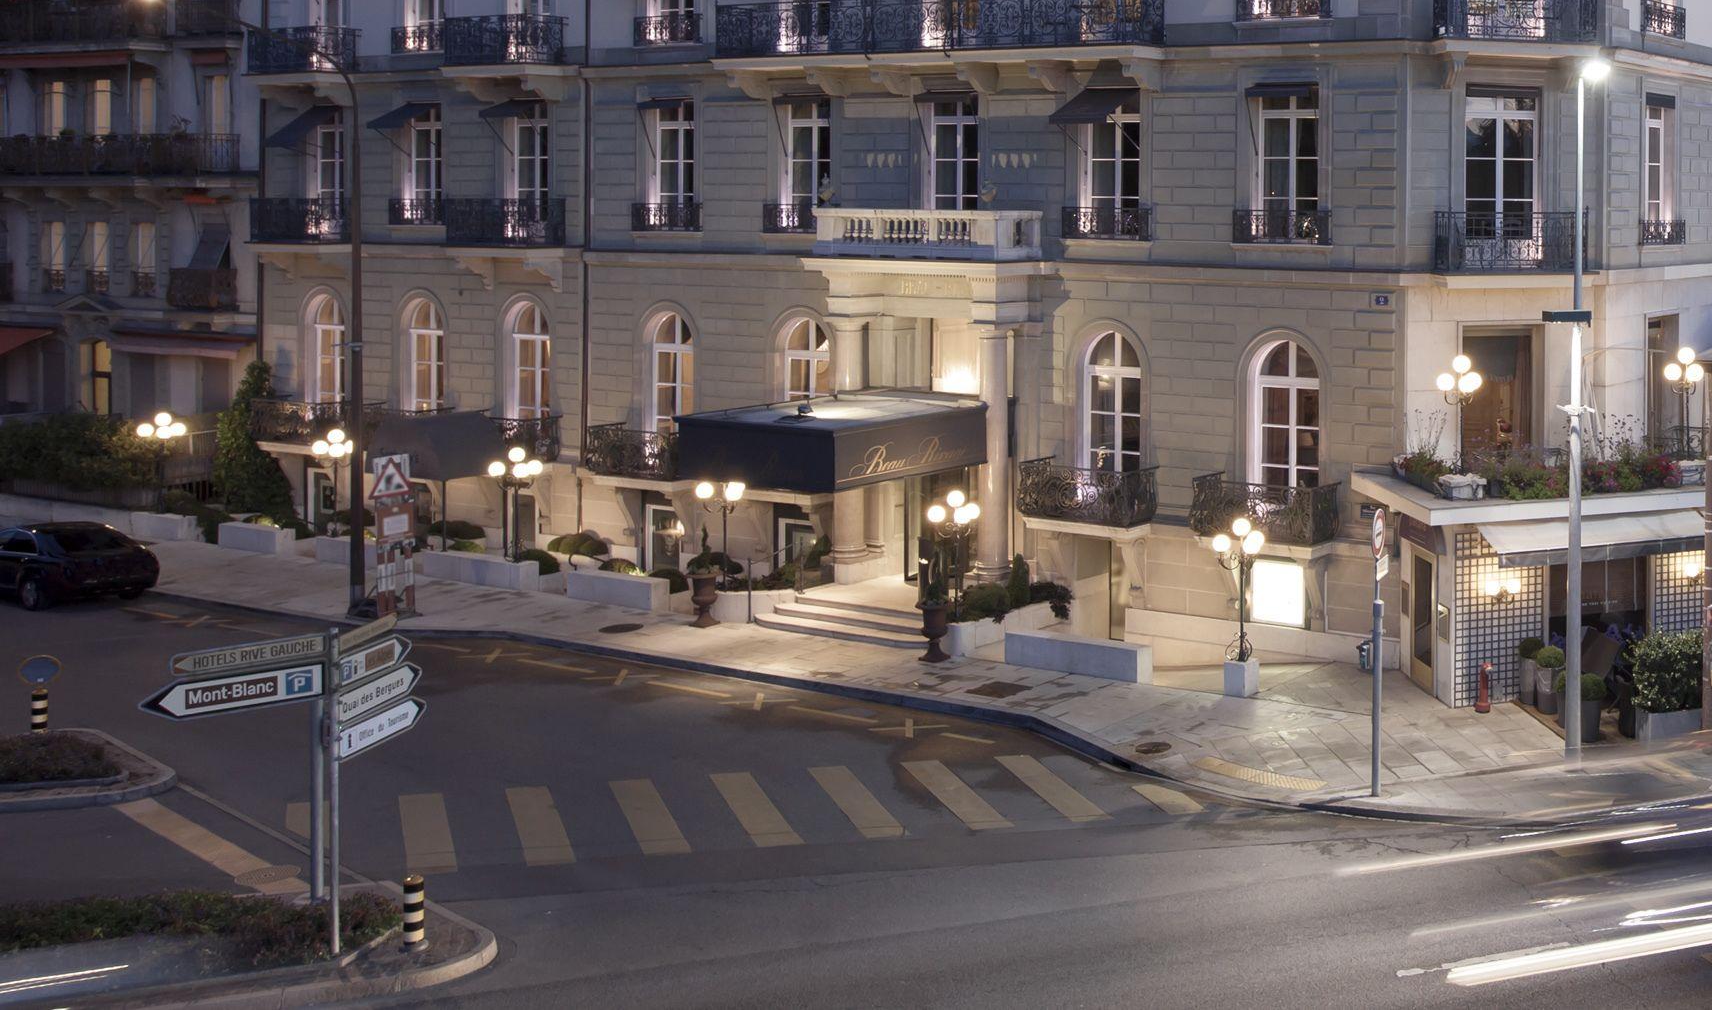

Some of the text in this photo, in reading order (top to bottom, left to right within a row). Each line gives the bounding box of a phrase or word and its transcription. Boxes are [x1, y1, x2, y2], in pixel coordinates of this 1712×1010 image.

[849, 441, 910, 477] Beau
[192, 640, 317, 670] HOTELS RIVE GAUCHE
[188, 679, 275, 705] Mont-Blanc
[343, 677, 404, 713] Quai des Bergues
